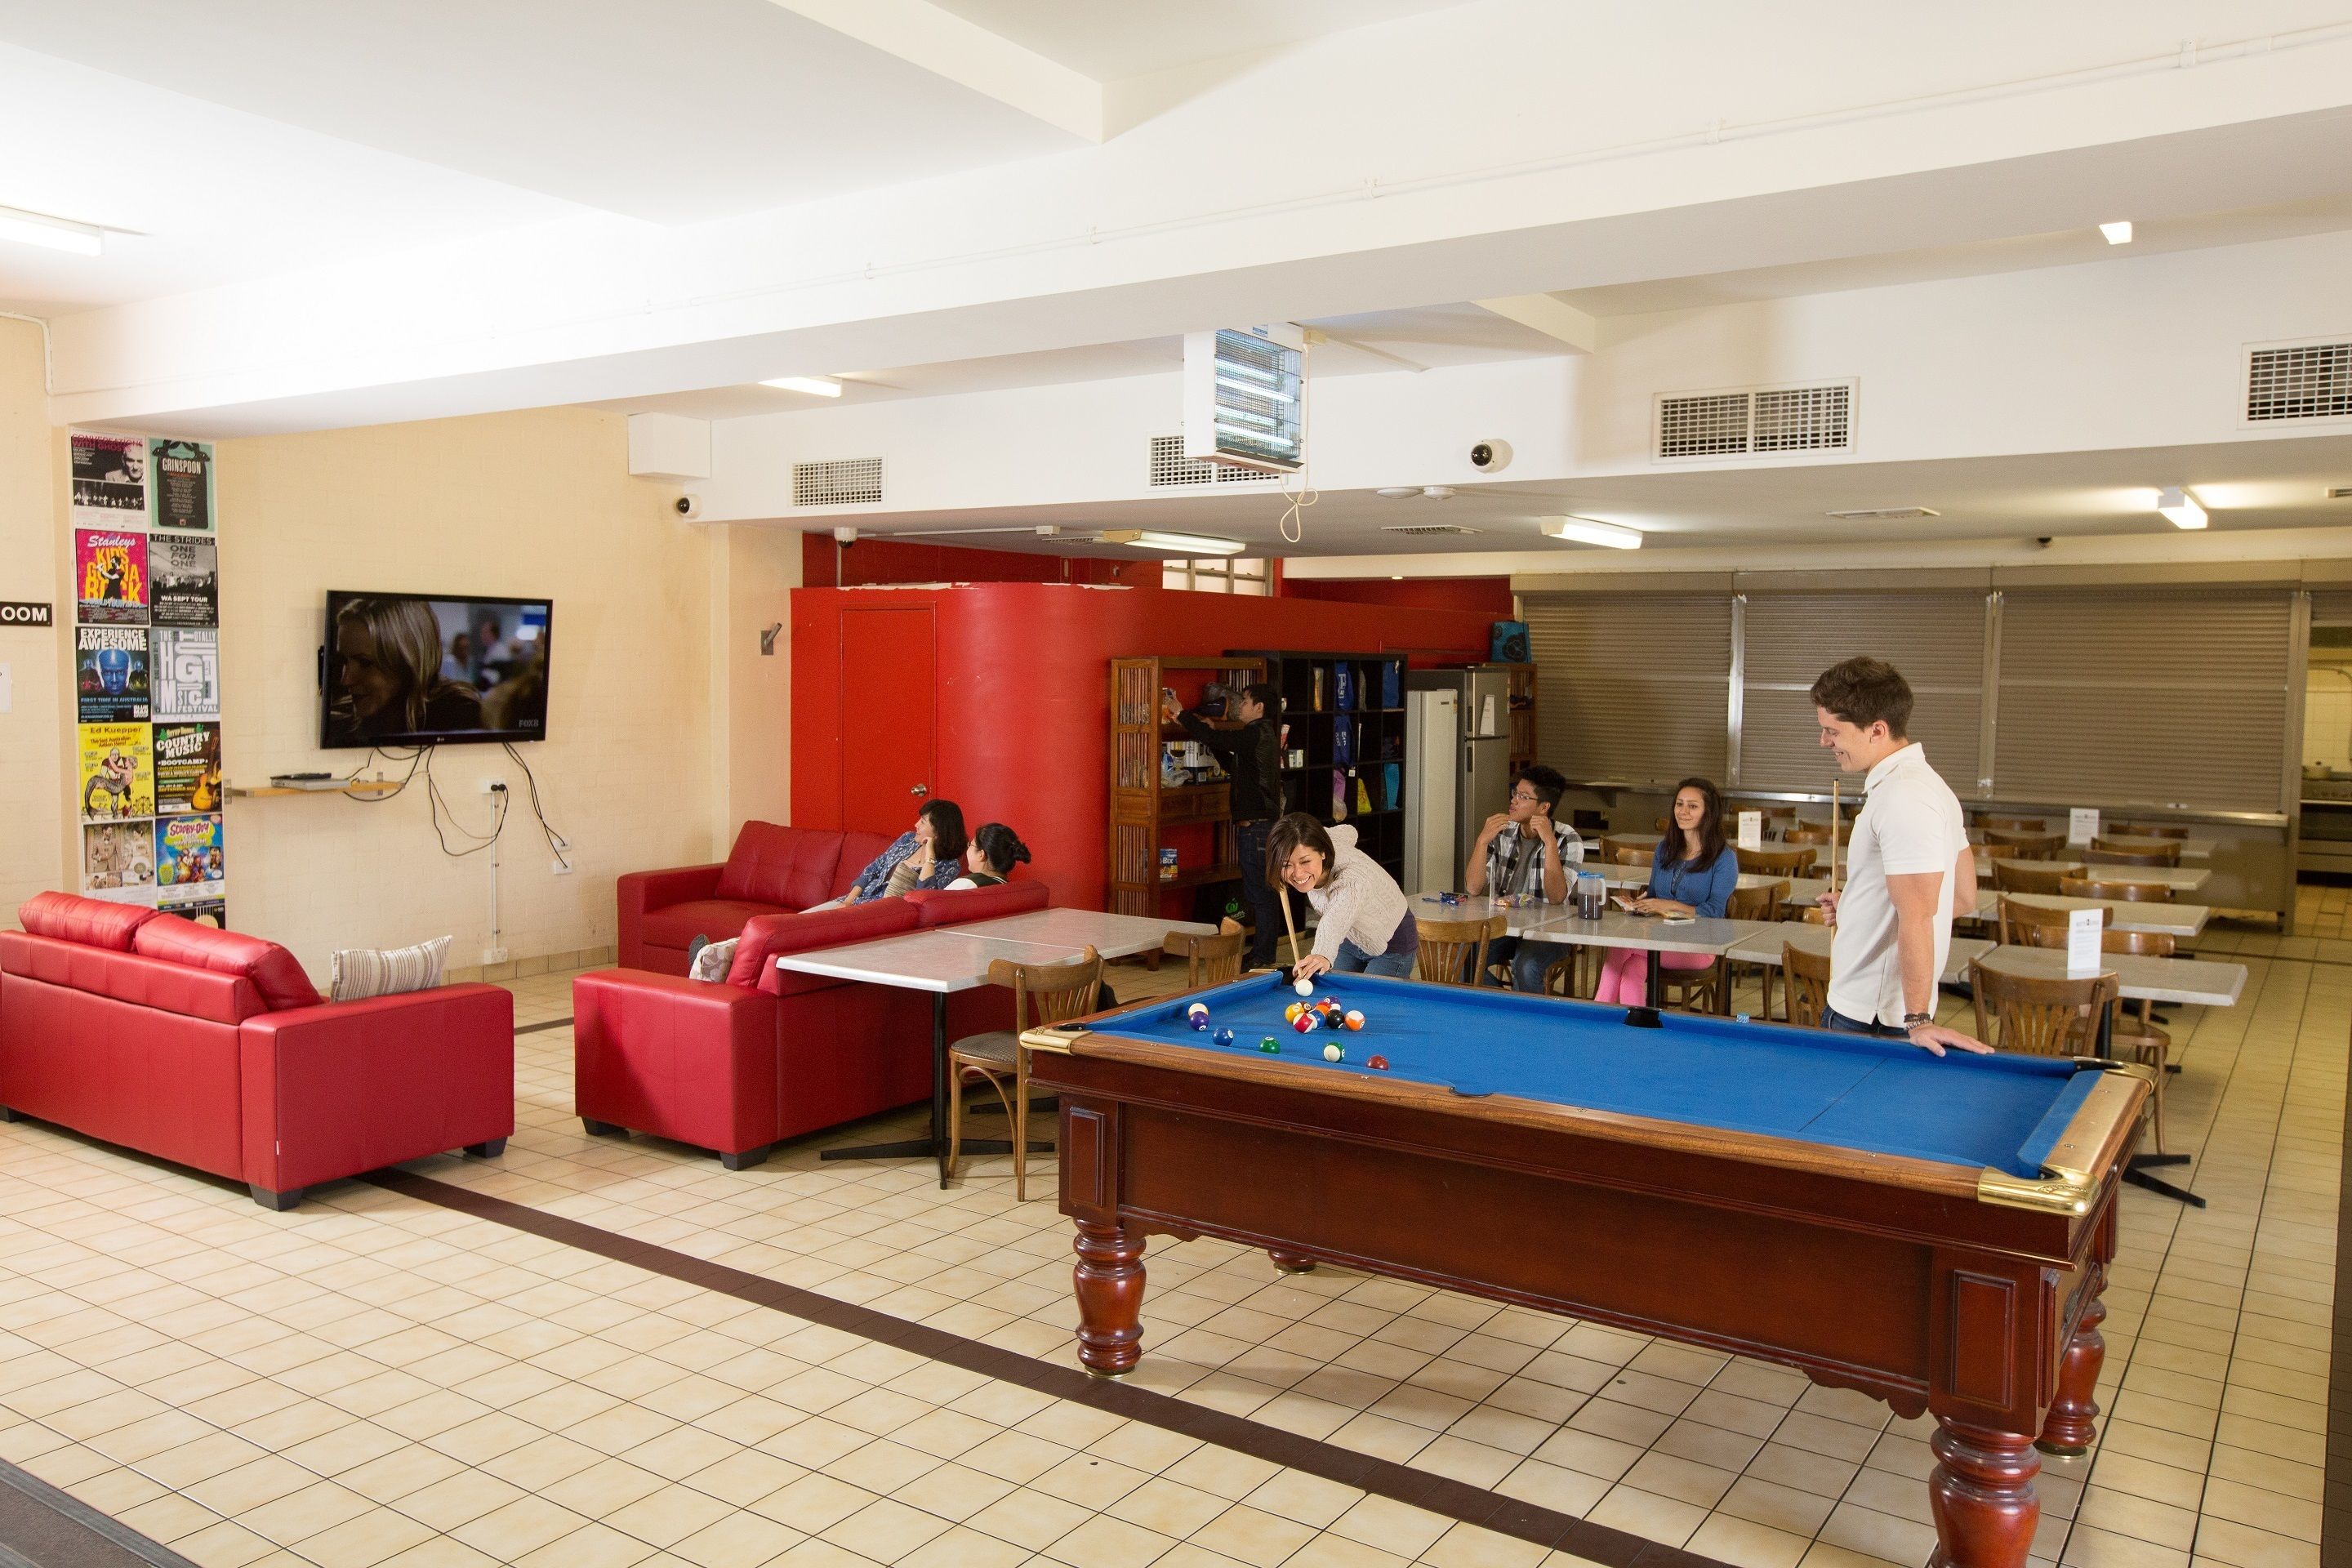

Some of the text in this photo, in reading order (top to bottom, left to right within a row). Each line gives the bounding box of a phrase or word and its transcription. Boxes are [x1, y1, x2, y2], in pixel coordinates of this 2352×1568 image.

[162, 458, 202, 474] GRINSPOON
[87, 535, 136, 549] Stanleys
[154, 534, 213, 545] THE STRIDES
[170, 545, 196, 553] ONE
[170, 552, 196, 560] FOR
[170, 559, 196, 568] ONE
[80, 628, 145, 639] EXPERIENCE
[160, 630, 172, 642] THE
[78, 637, 148, 652] AWESOME
[177, 705, 218, 713] FESTIVAL
[519, 719, 540, 728] FOX8
[156, 731, 210, 751] COUNTRY
[165, 742, 203, 760] MUSIC
